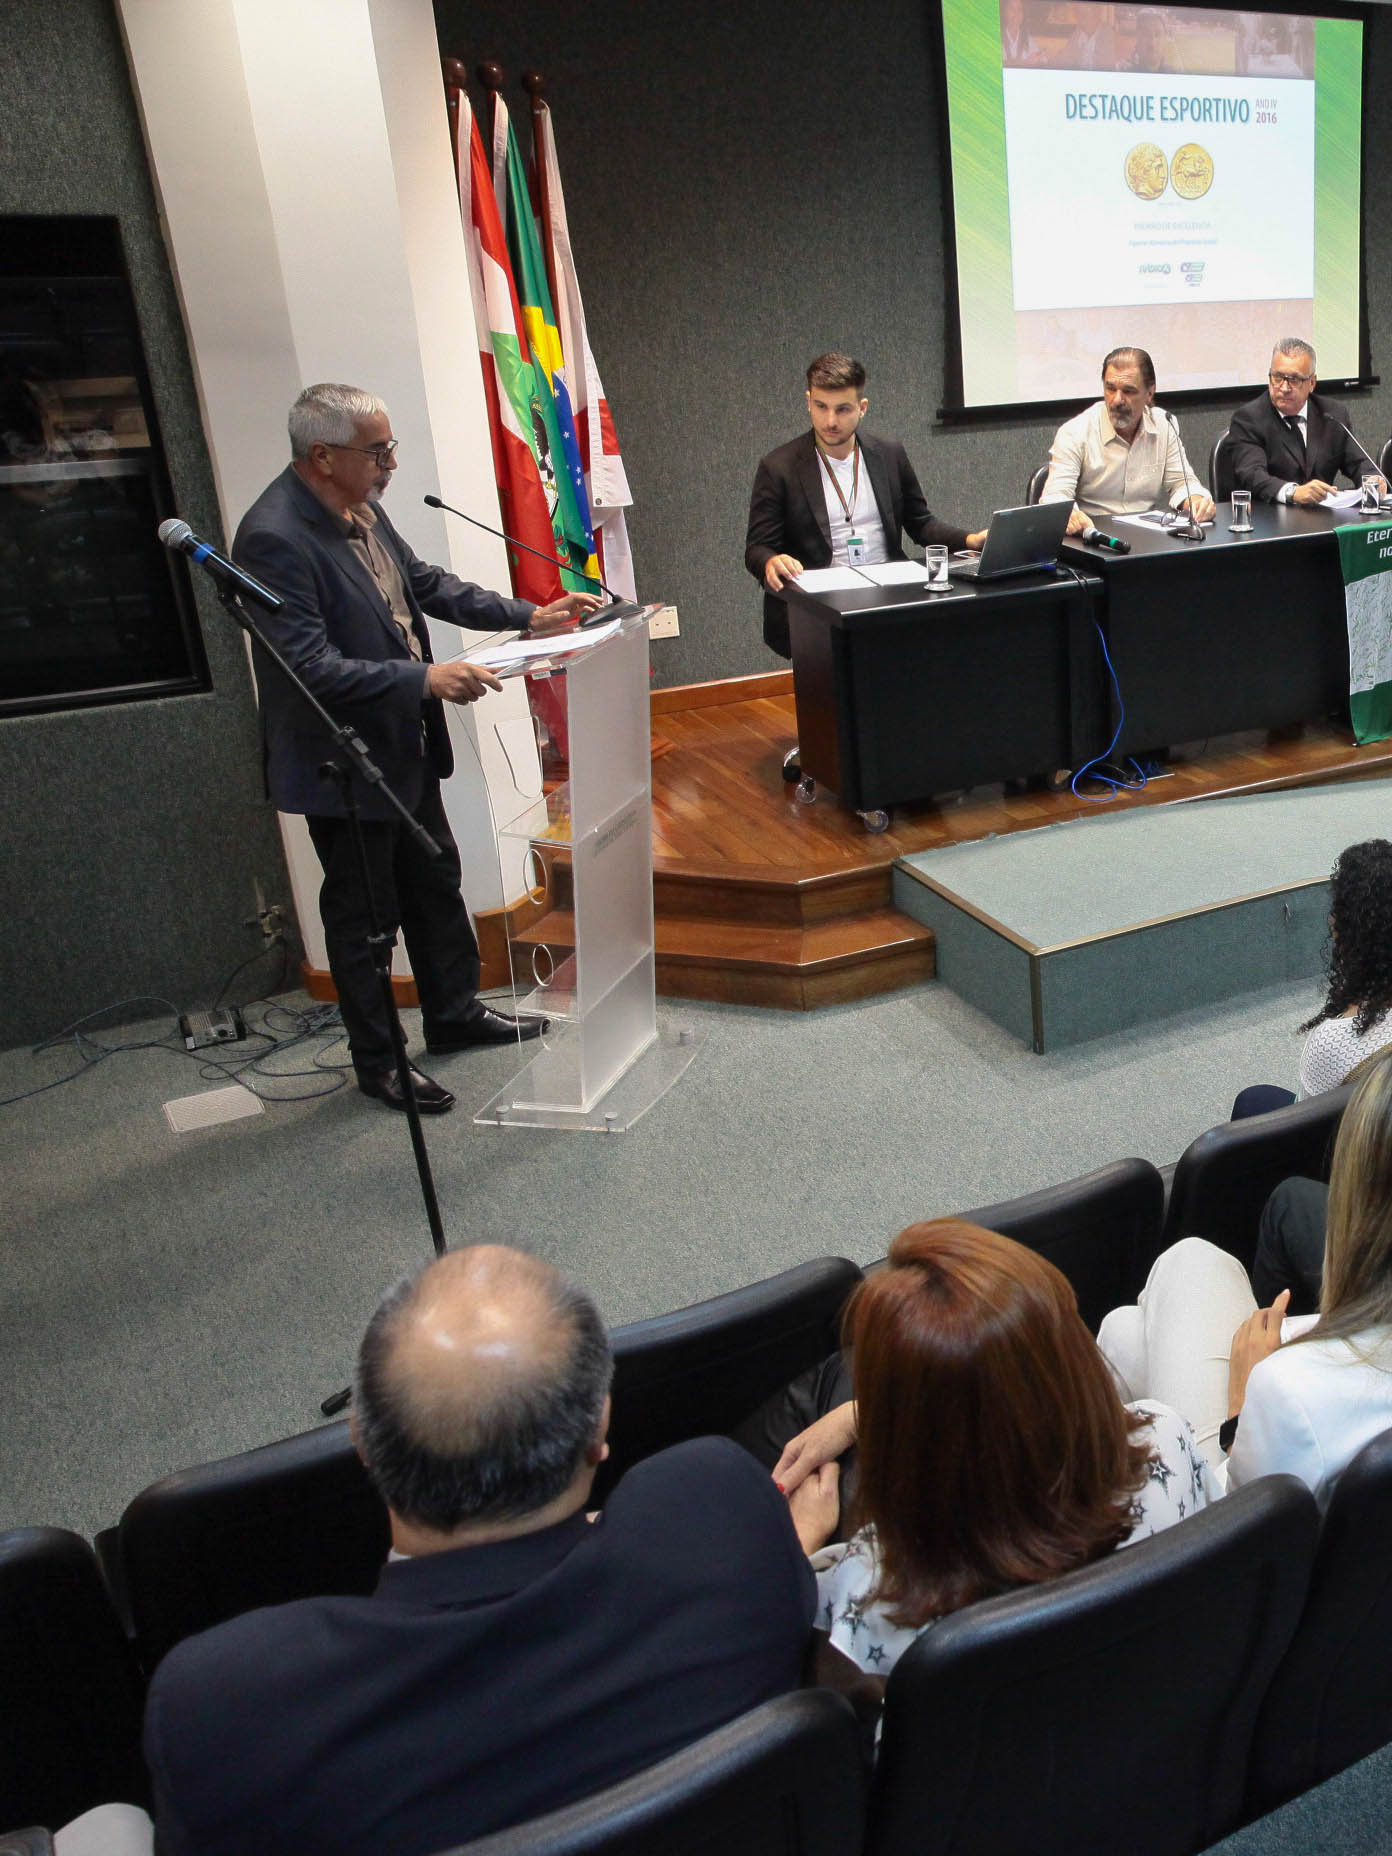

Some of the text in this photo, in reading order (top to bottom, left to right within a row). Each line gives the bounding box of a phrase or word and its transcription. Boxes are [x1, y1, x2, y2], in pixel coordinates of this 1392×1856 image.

[1065, 93, 1250, 123] DESTAQUE ESPORTIVO
[1256, 112, 1277, 124] 2016
